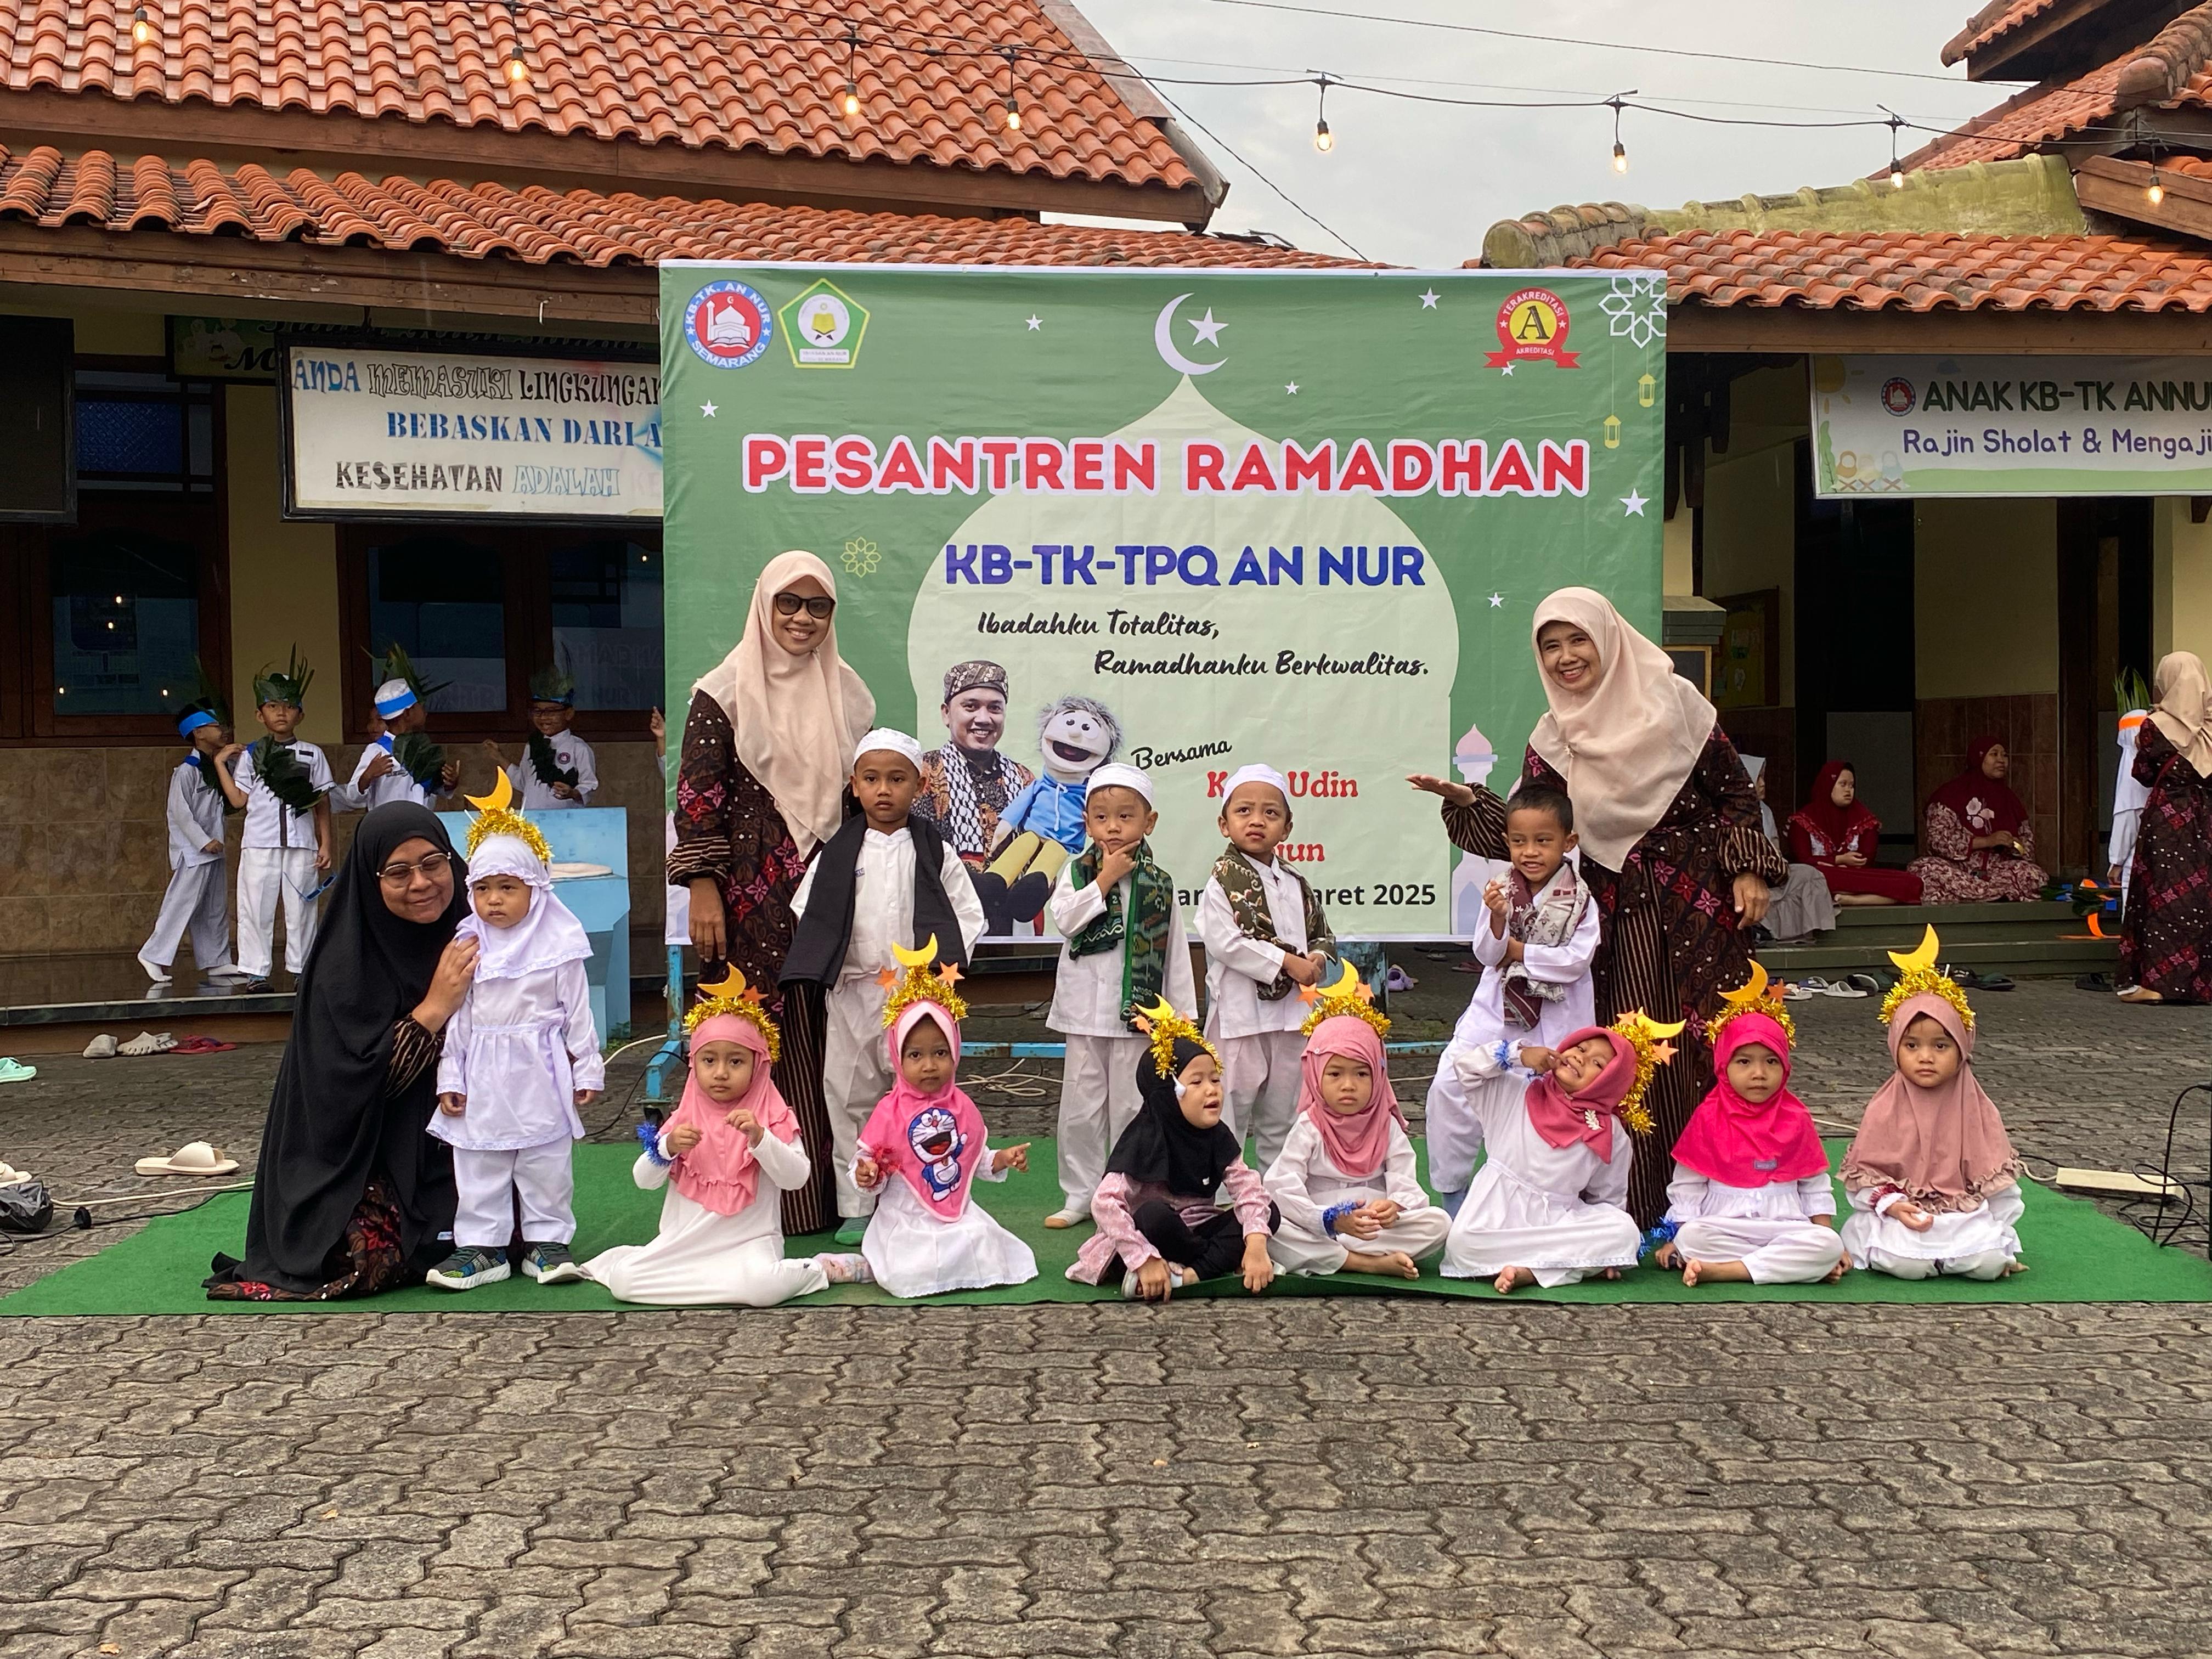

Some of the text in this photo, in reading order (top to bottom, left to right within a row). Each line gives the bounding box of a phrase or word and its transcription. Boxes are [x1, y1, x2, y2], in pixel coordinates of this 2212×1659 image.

[725, 283, 746, 295] AN
[749, 294, 771, 323] NUR
[1503, 291, 1565, 317] TERAKREDITASI
[1516, 305, 1550, 339] A
[692, 341, 766, 368] SEMARANG
[1516, 347, 1555, 357] AKREDITASI
[293, 359, 360, 392] ANDA
[367, 363, 513, 399] MEMASUKI
[1923, 381, 2013, 411] ANAK
[2021, 381, 2117, 411] KB-TK
[2124, 381, 2212, 411] ANNU
[387, 411, 662, 447] BEBASKAN DARI A
[1903, 428, 2212, 460] Rajin Sholat & Mengaji
[335, 461, 504, 493] KESEHATAN
[512, 465, 620, 496] ADALAH
[747, 439, 1585, 493] PESANTREN RAMADHAN
[946, 545, 1426, 586] KB-TK-TPQ AN NUR
[978, 608, 1220, 641] Ibadahku Totalitas,
[1094, 650, 1429, 676] Ramadhanku Berkwalitas.
[1131, 741, 1232, 770] Bersama
[1288, 771, 1358, 798] Udin
[1313, 884, 1365, 906] aret
[1373, 884, 1436, 906] 2025
